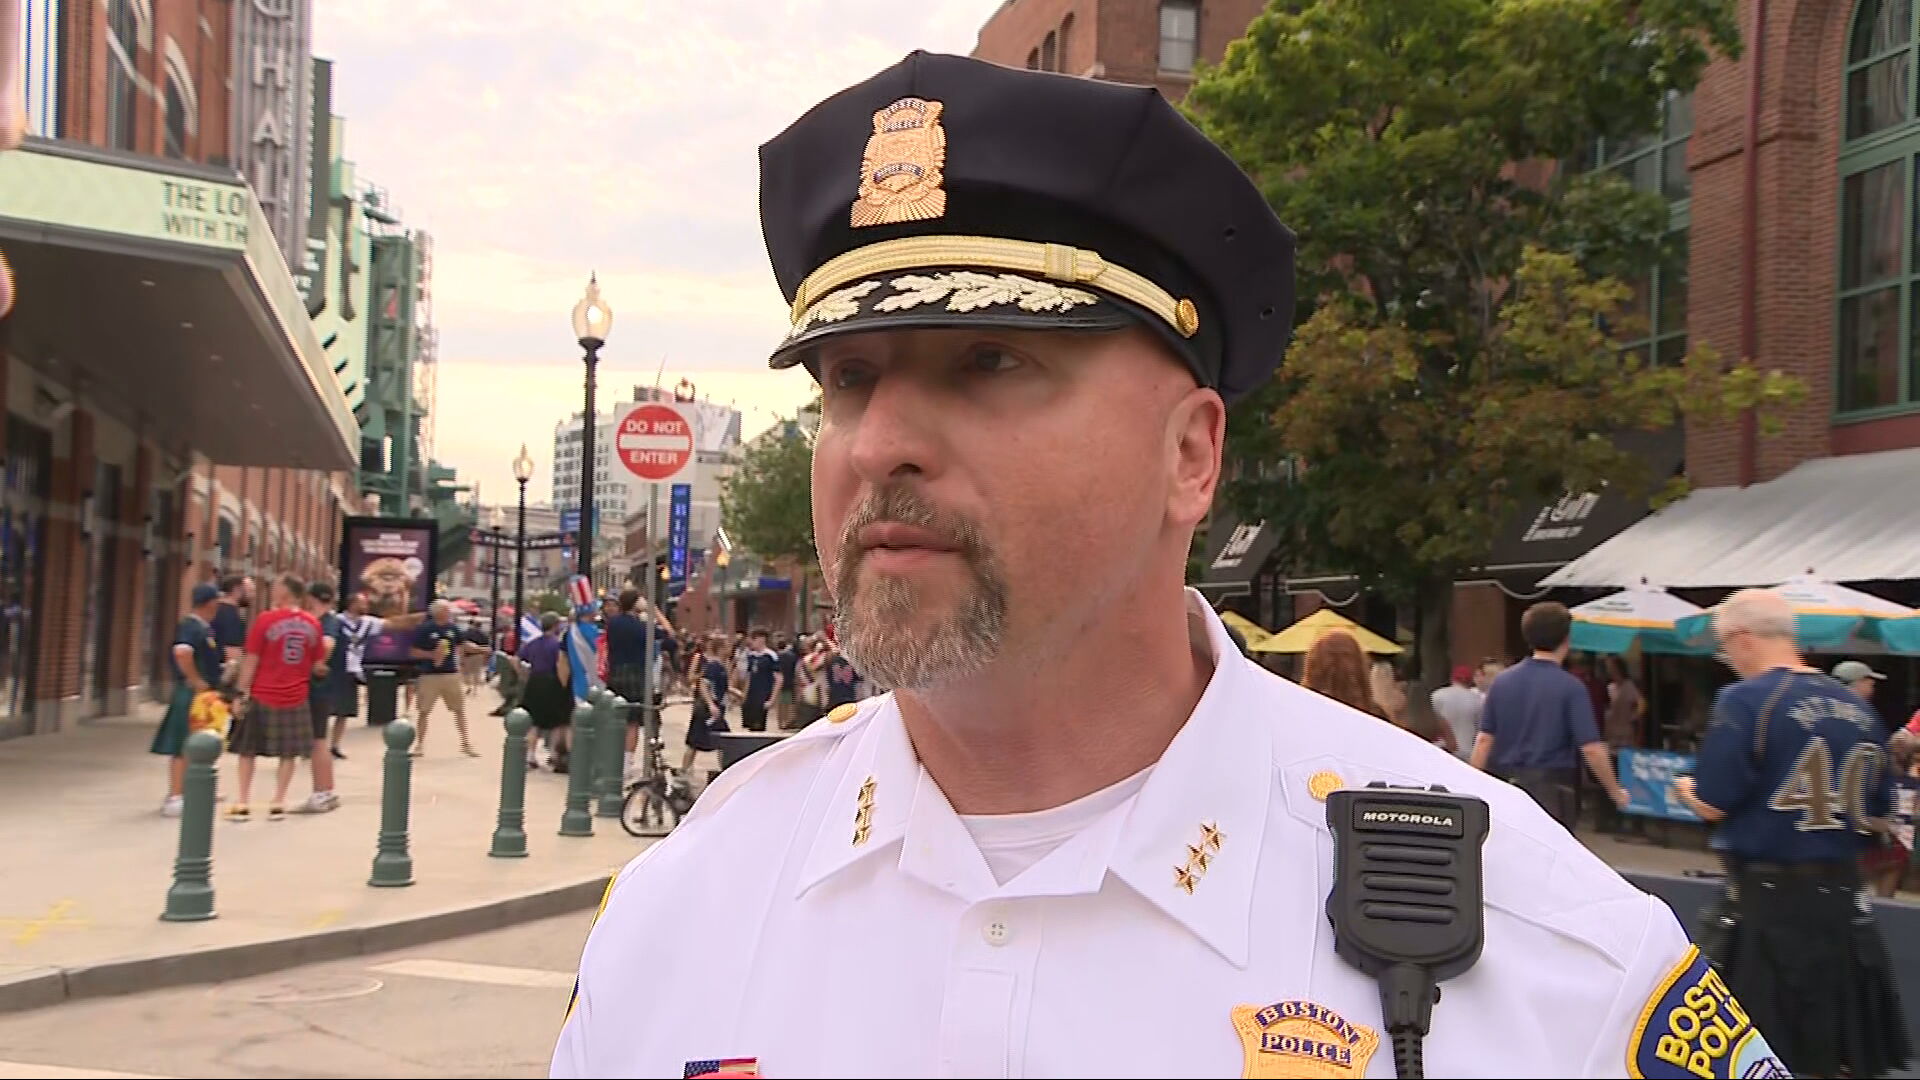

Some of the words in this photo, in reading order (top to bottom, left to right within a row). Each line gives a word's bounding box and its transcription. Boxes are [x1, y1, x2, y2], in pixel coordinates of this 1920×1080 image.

[883, 99, 926, 120] BOSTON
[884, 120, 923, 132] POLICE
[163, 180, 206, 211] THE
[164, 213, 217, 240] WITH
[626, 420, 648, 432] DO
[653, 421, 681, 433] NOT
[630, 451, 678, 464] ENTER
[1363, 812, 1453, 826] MOTOROLA
[1262, 1001, 1356, 1043] BOSTON
[1655, 967, 1730, 1068] BOST
[1266, 1034, 1349, 1062] POLICE
